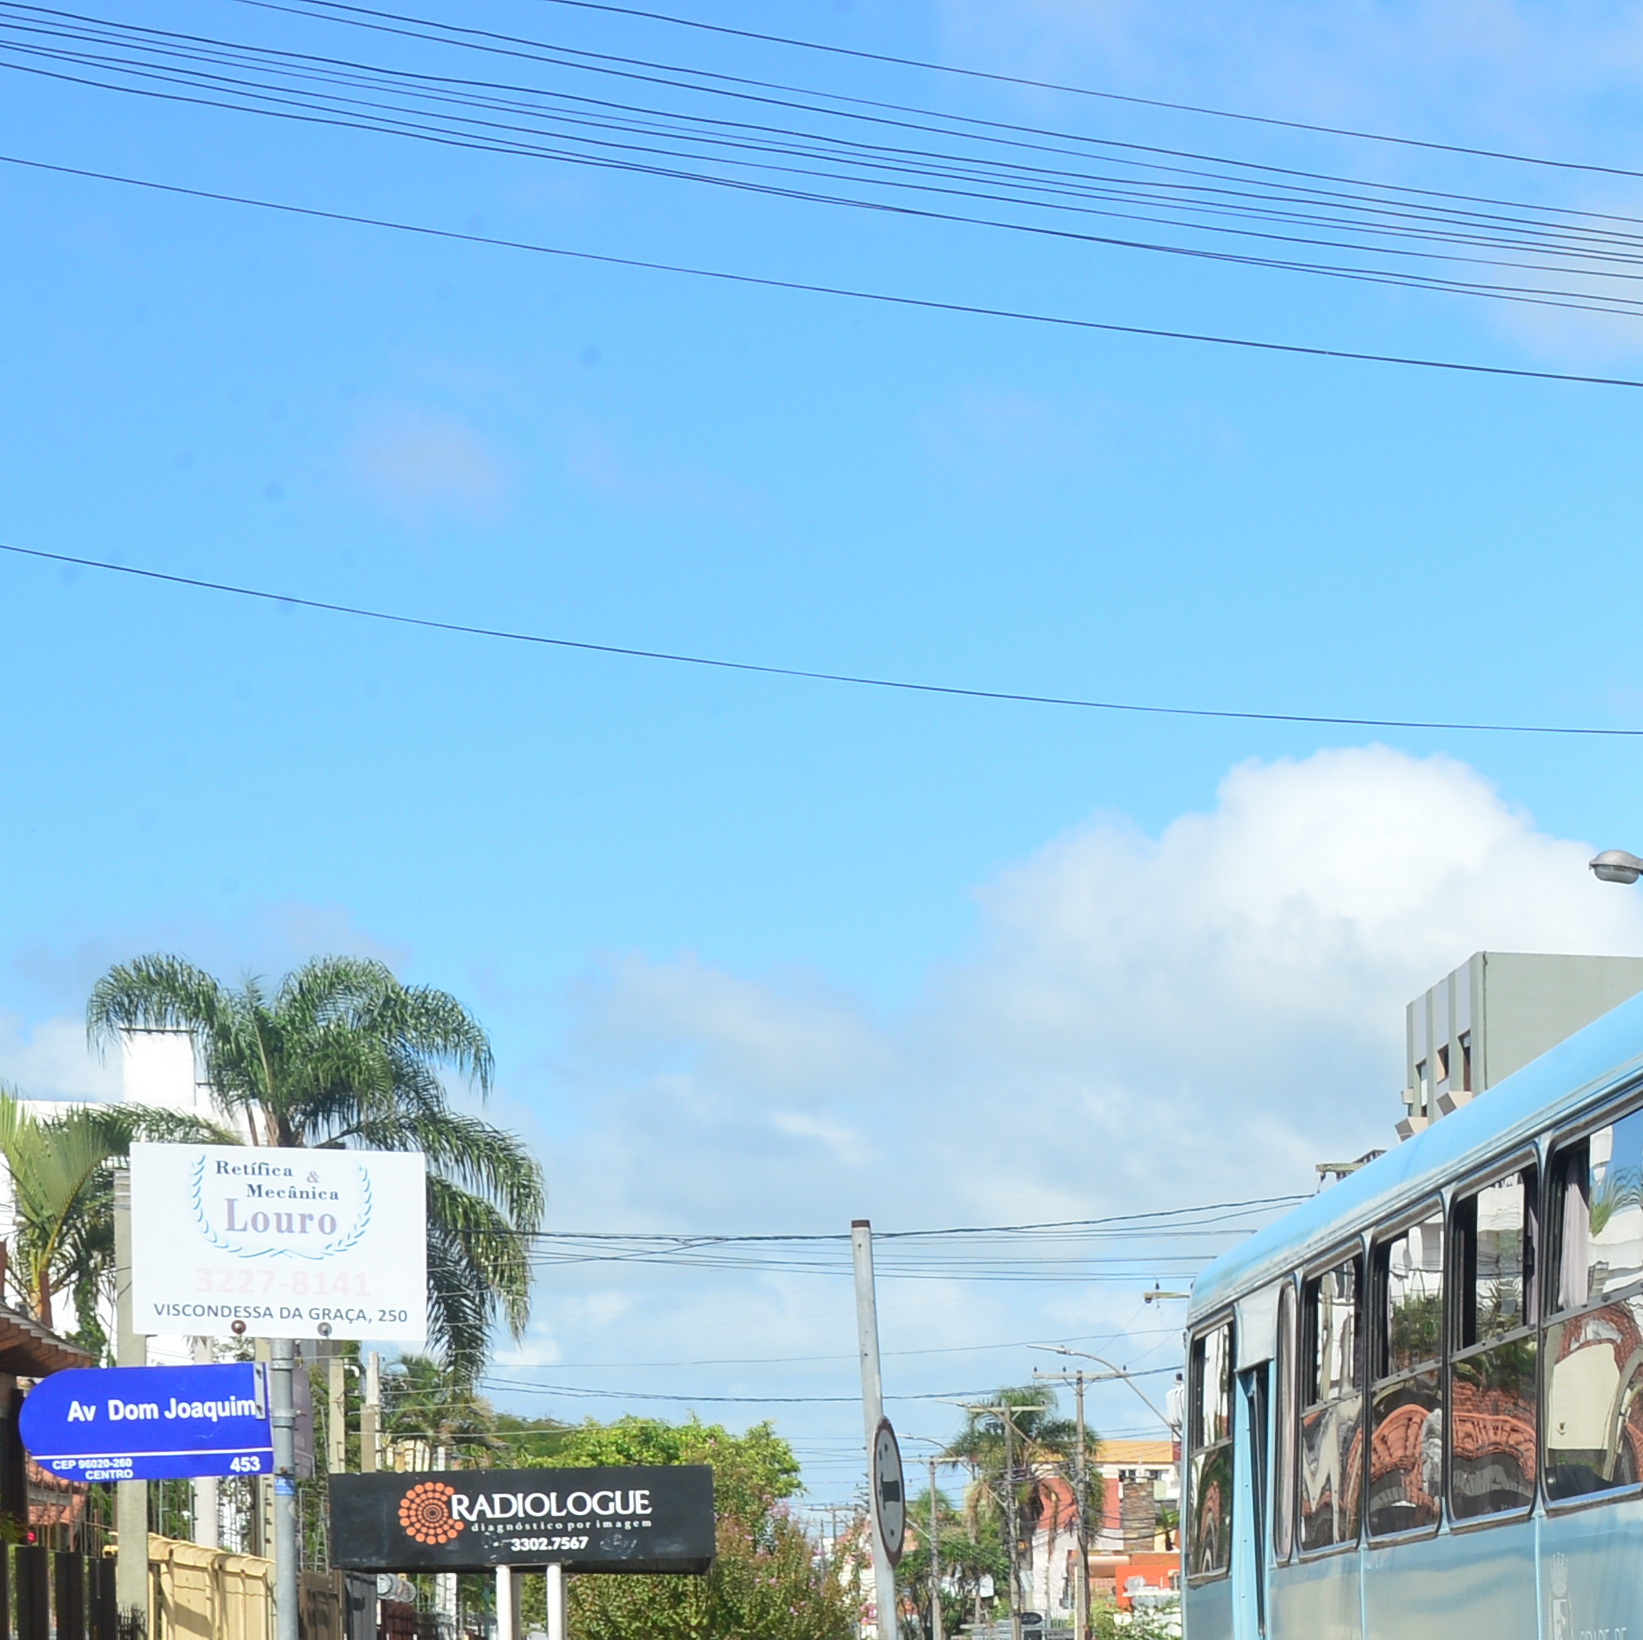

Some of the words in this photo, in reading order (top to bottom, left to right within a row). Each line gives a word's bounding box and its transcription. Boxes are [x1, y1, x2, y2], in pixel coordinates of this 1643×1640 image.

[215, 1159, 293, 1177] Retífica
[306, 1170, 320, 1184] &
[246, 1183, 339, 1201] Mecânica
[224, 1198, 337, 1235] Louro
[195, 1267, 370, 1297] 3227-8141
[153, 1303, 273, 1319] VISCONDESSA
[279, 1306, 301, 1320] DA
[308, 1308, 372, 1325] GRAÇA,
[378, 1309, 408, 1323] 250
[67, 1400, 97, 1422] Av
[108, 1398, 159, 1421] Dom
[164, 1395, 256, 1422] Joaquim
[52, 1461, 76, 1470] CEP
[78, 1458, 132, 1469] 96020-260
[229, 1456, 261, 1472] 453
[85, 1469, 133, 1480] CENTRO
[451, 1490, 653, 1521] RADIOLOGUE
[470, 1521, 563, 1534] diagnóstico
[567, 1521, 592, 1532] por
[595, 1519, 652, 1530] imagem
[510, 1536, 589, 1551] 3302.7567
